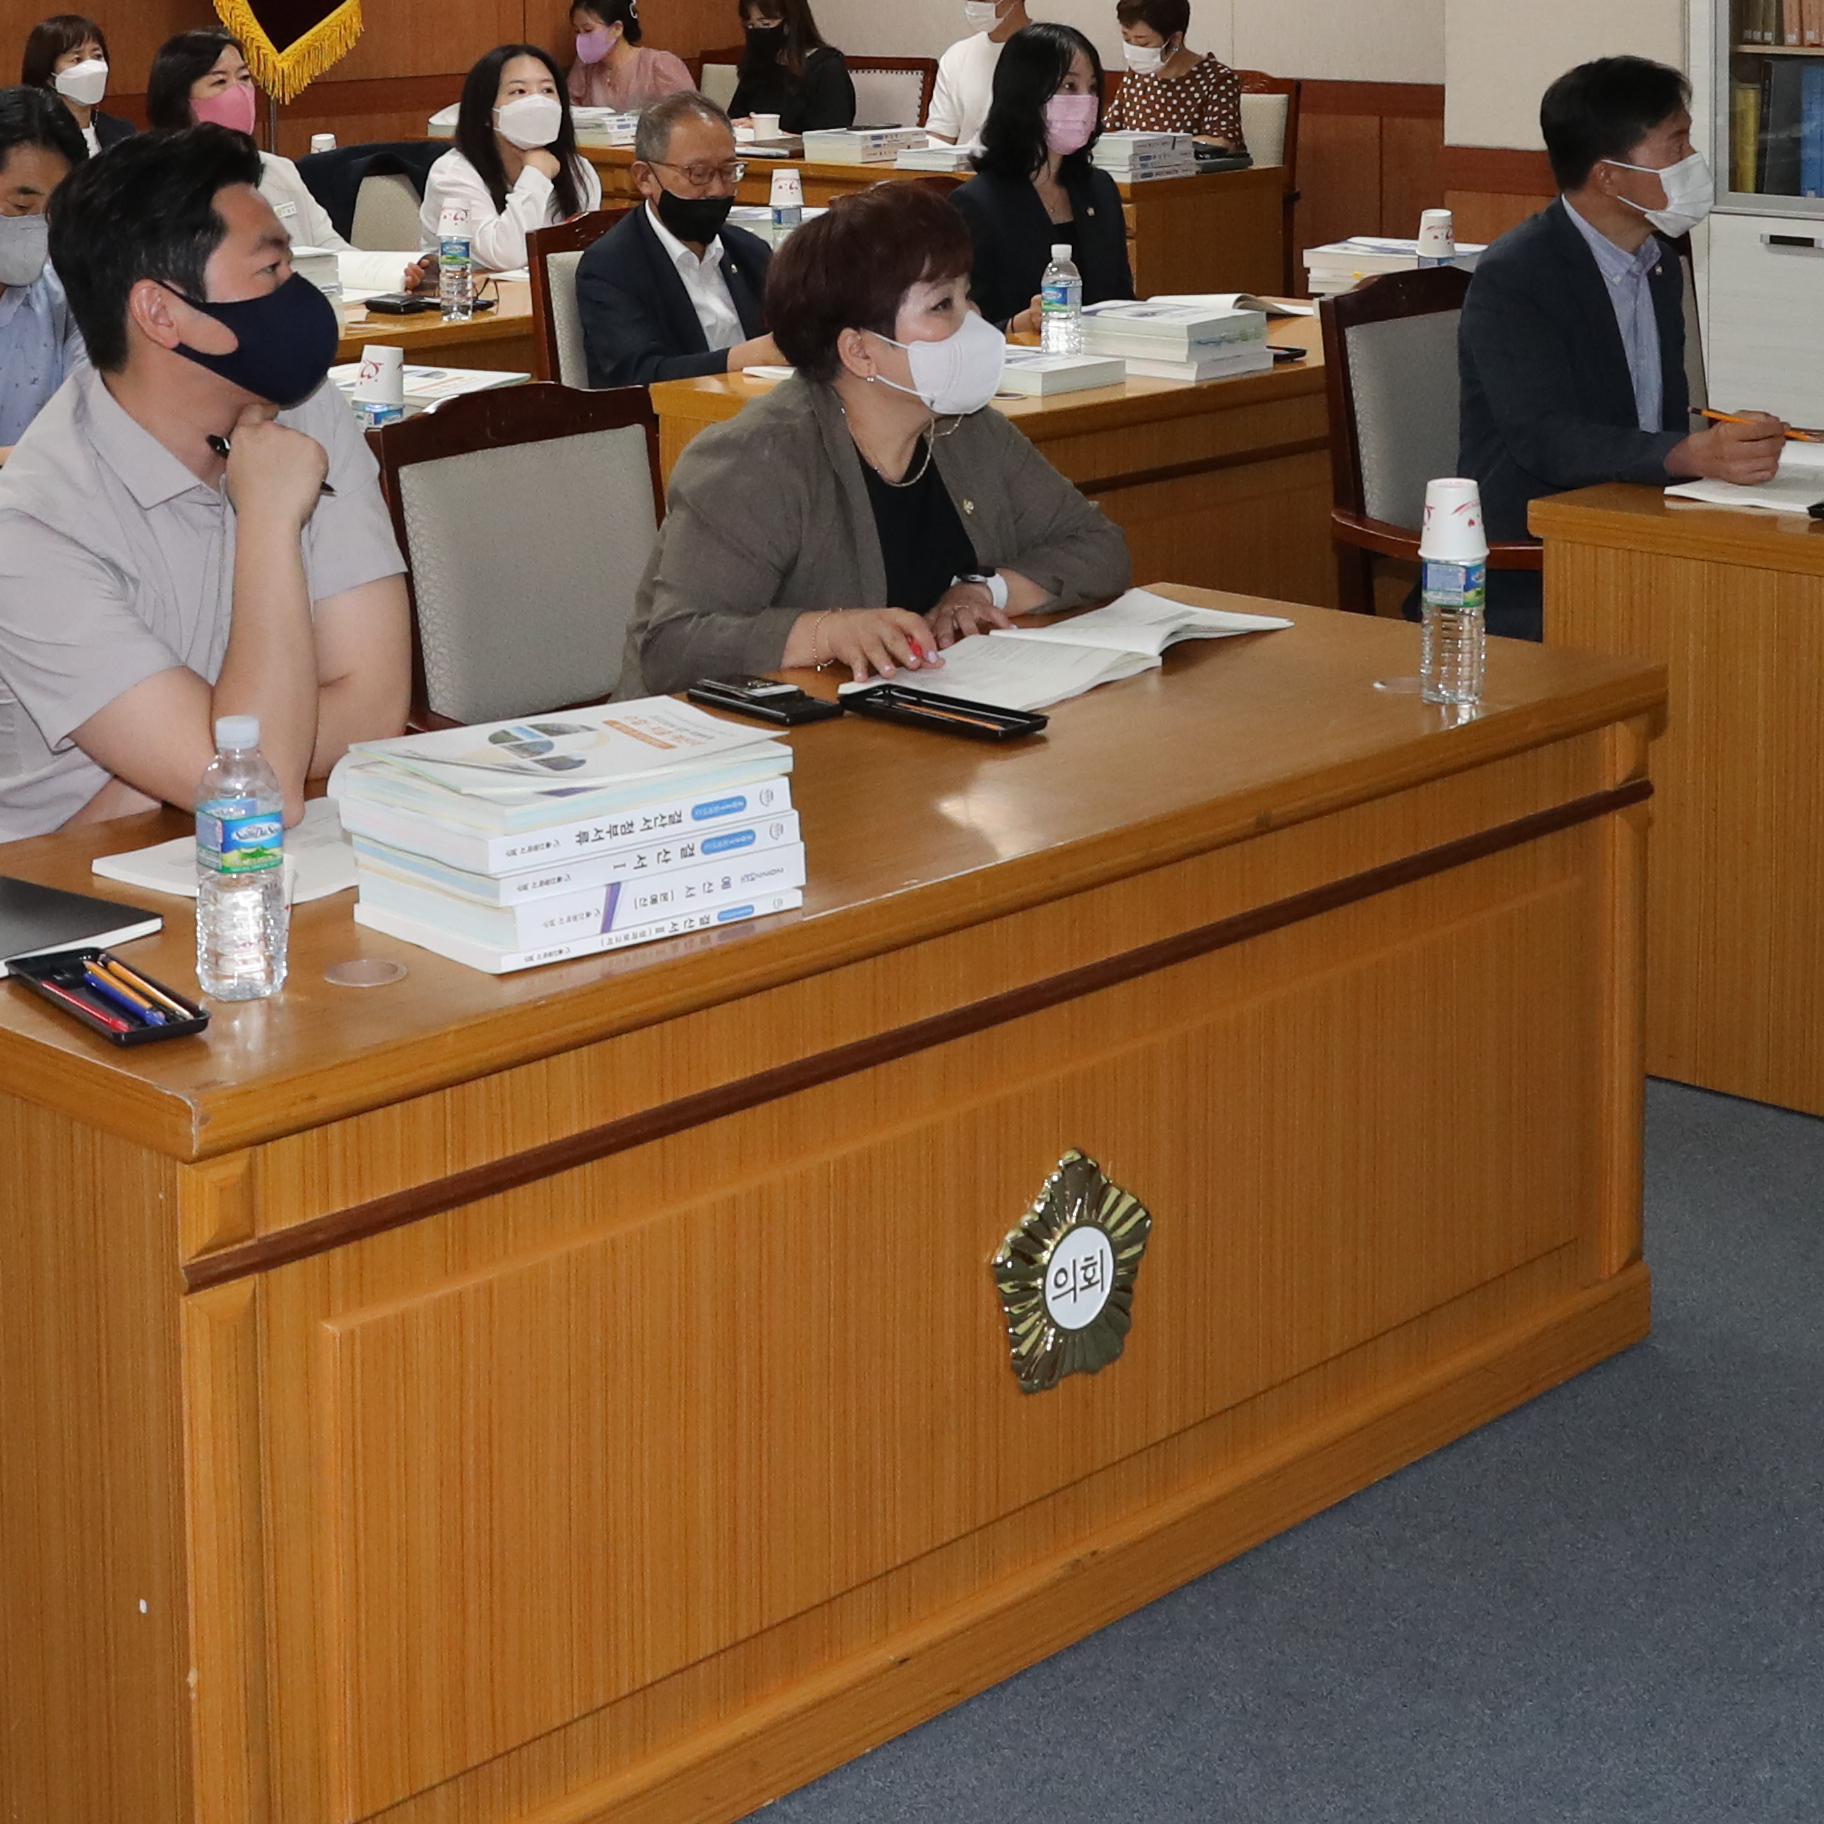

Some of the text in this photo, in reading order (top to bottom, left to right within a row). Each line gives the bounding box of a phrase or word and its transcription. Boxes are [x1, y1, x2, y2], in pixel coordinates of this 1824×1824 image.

[574, 820, 635, 846] 첨부서류
[639, 810, 683, 833] 결산서
[1051, 1248, 1105, 1304] 의회
